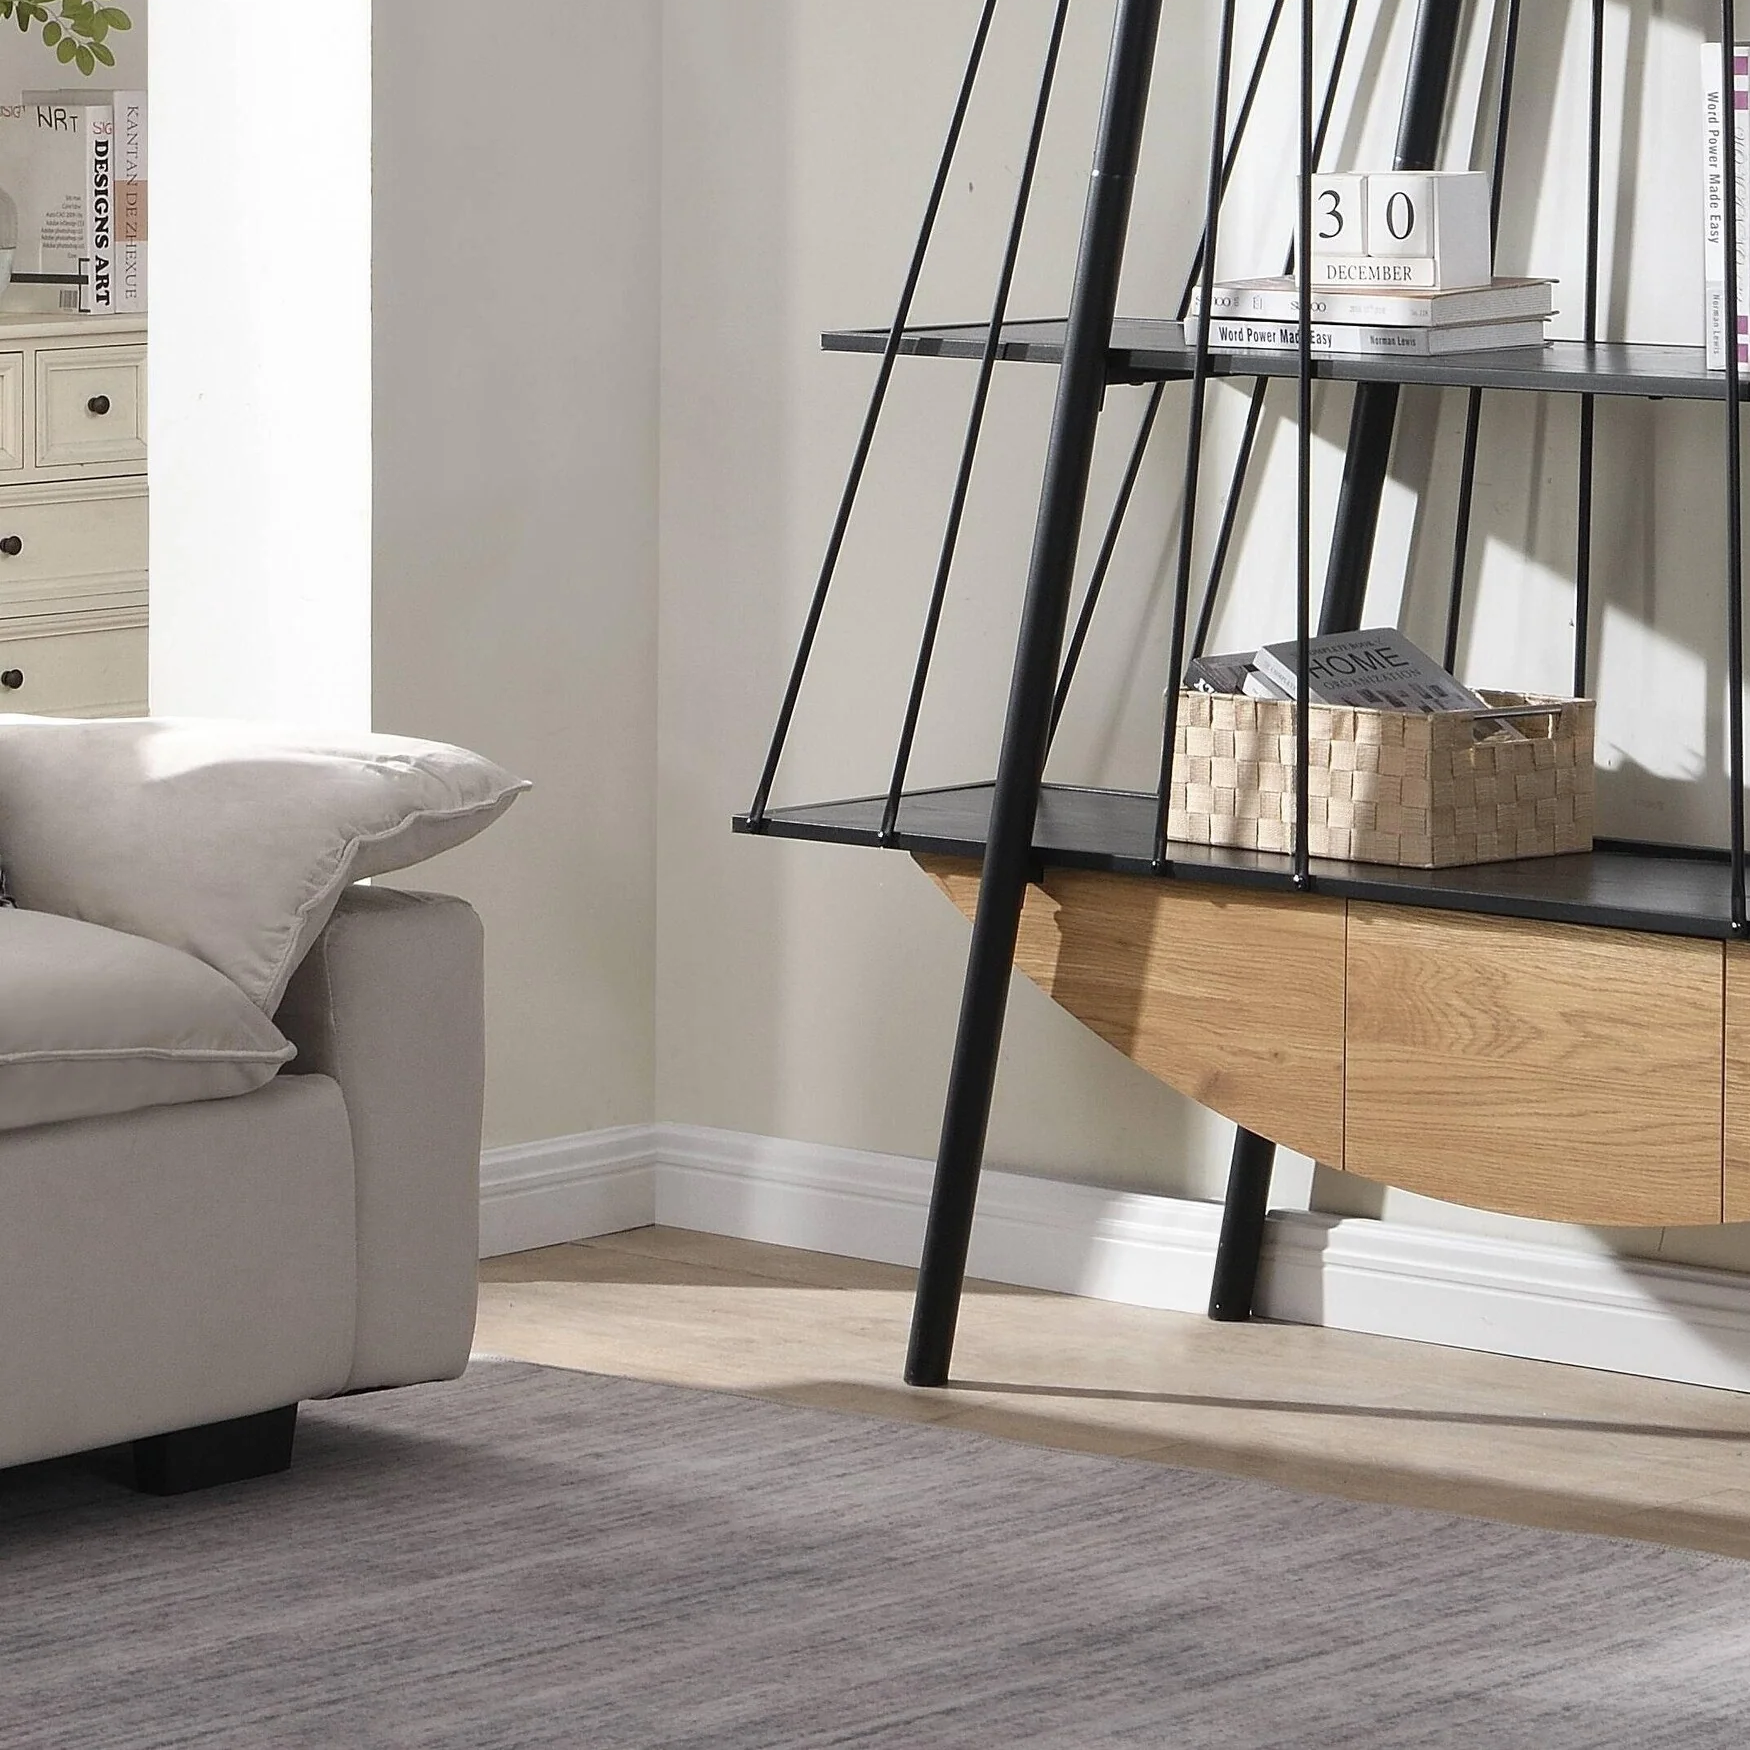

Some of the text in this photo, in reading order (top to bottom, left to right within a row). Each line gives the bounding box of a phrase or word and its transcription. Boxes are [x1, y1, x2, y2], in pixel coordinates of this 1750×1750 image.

[1707, 92, 1721, 244] Word Power Made Easy
[94, 139, 110, 306] DESIGNS ART
[125, 106, 139, 299] KANTAN DE ZHEXUE
[1318, 190, 1415, 240] 3 0
[1326, 264, 1412, 281] DECEMBER
[1218, 326, 1416, 348] Word Power Mad Easy Norman Lewis
[1712, 294, 1720, 354] Norman Lewis
[1308, 647, 1410, 679] HOME
